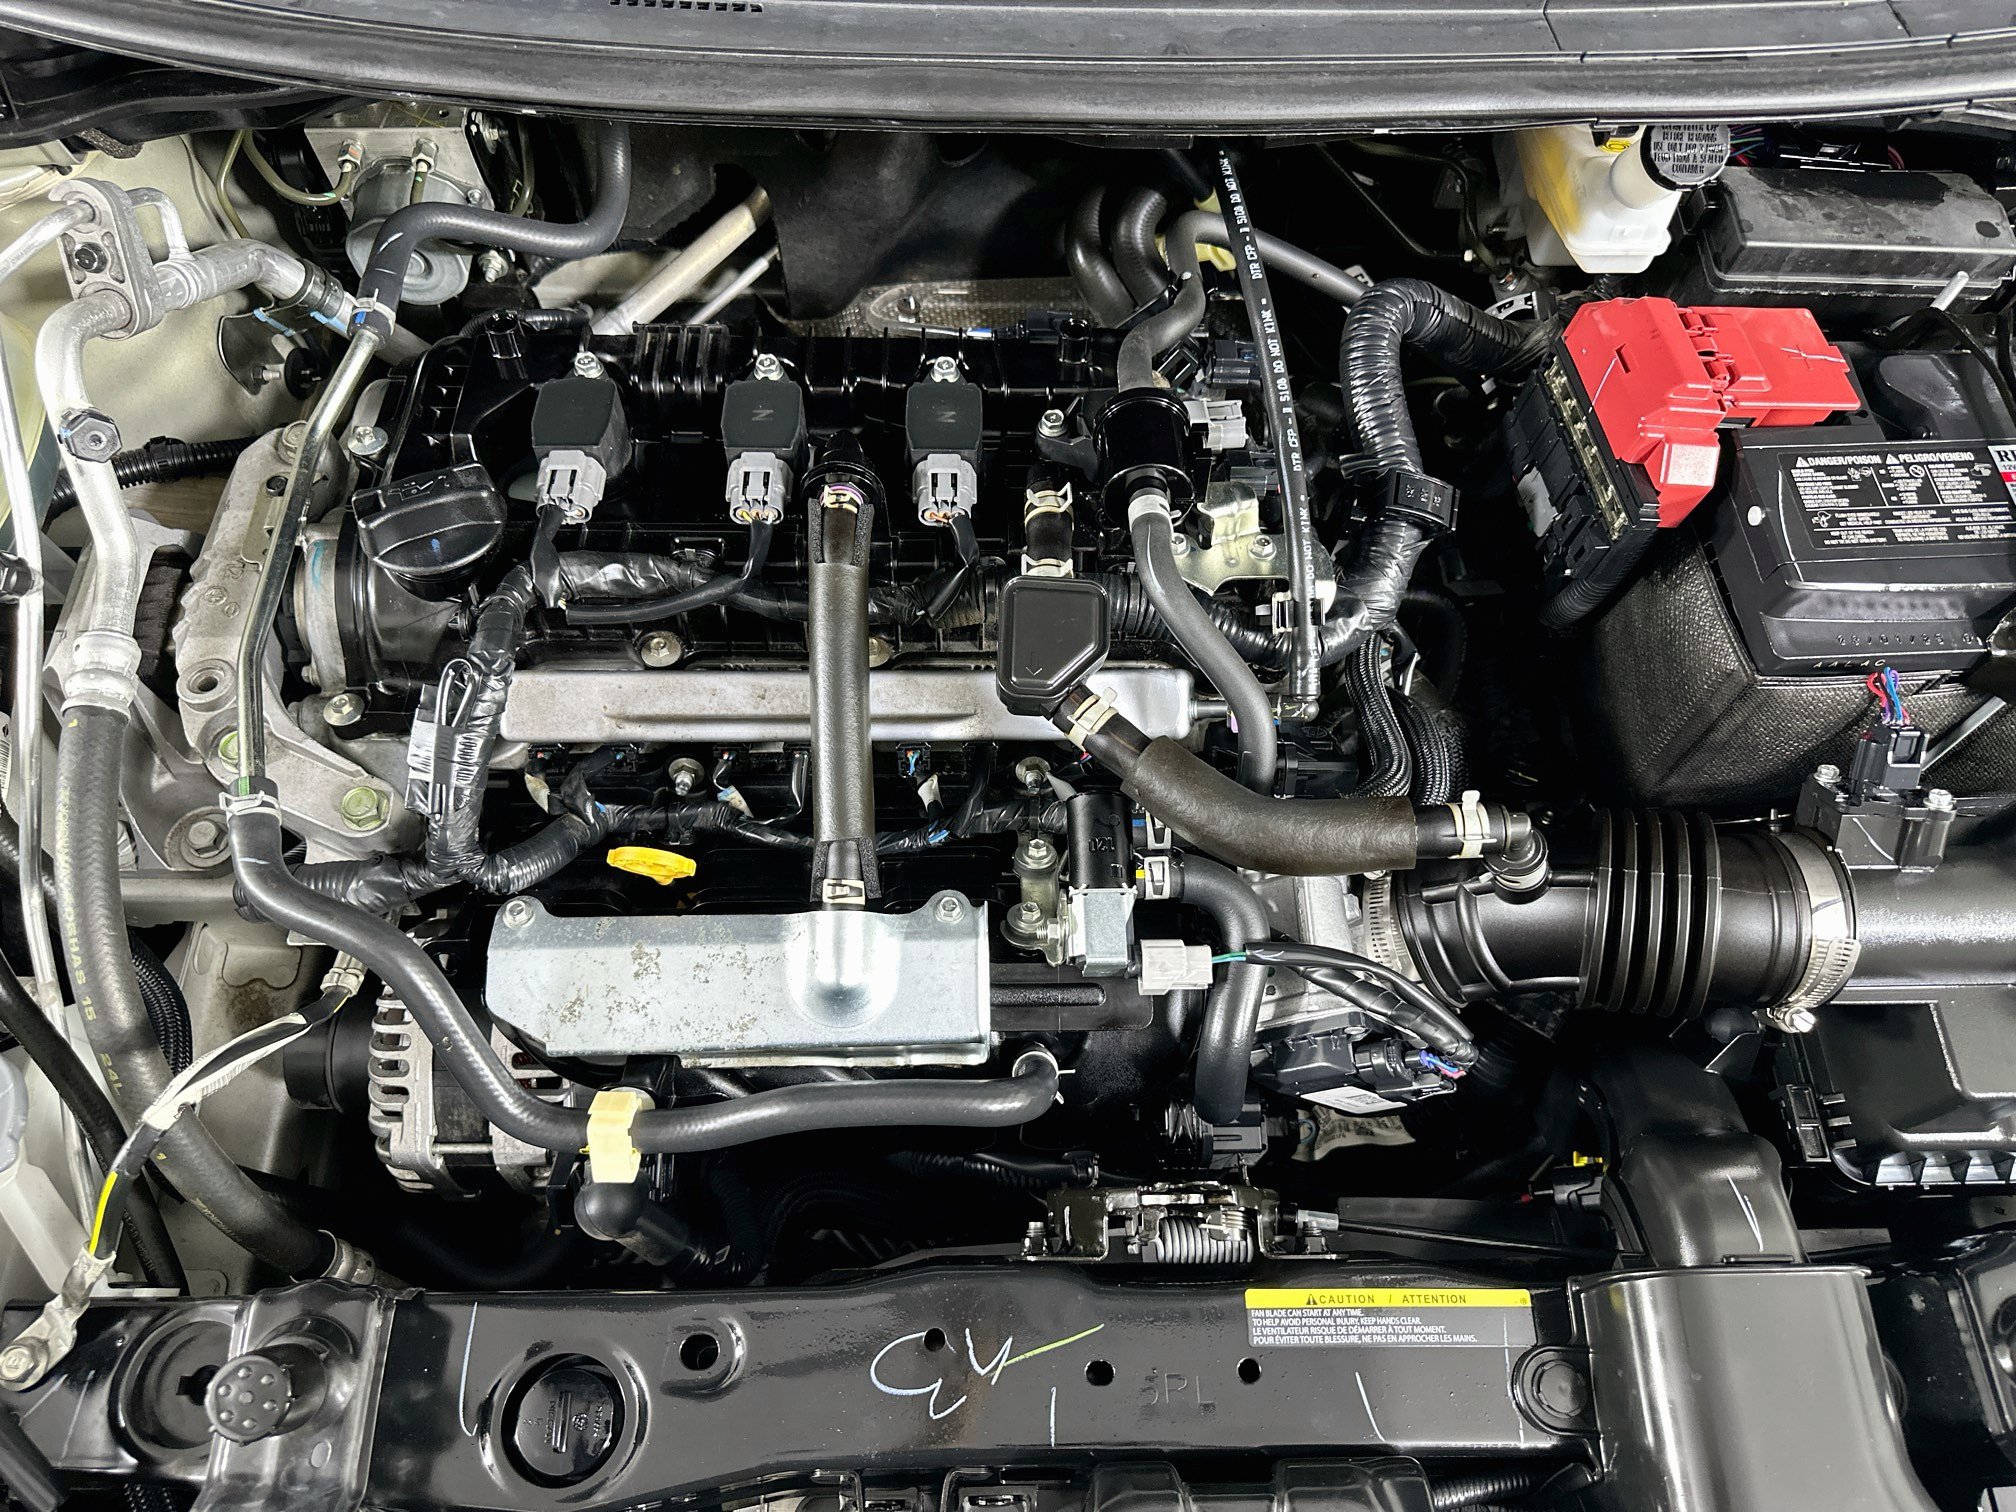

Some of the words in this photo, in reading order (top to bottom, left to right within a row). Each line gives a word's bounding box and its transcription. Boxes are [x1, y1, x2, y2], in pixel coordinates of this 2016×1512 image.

[1224, 178, 1237, 191] NOT
[1229, 193, 1241, 203] DO
[1244, 244, 1257, 260] CFP
[1249, 262, 1262, 280] DTR
[1261, 309, 1276, 334] KINK
[1267, 339, 1281, 357] NOT
[1272, 360, 1285, 373] DO
[1286, 428, 1299, 448] CFP
[1291, 452, 1302, 472] DTR
[1807, 455, 1882, 466] DANGER/POISON
[1898, 451, 1975, 463] PELIGRO/VENENO
[1299, 506, 1311, 533] KINK
[1302, 539, 1313, 560] NOT
[1319, 1294, 1375, 1304] CAUTION
[1402, 1294, 1467, 1304] ATTENTION
[1251, 1309, 1265, 1317] FAN
[1265, 1309, 1287, 1317] BLADE
[1287, 1309, 1301, 1317] CAN
[1302, 1309, 1322, 1317] START
[1347, 1308, 1364, 1316] TIME.
[1252, 1318, 1262, 1326] TO
[1263, 1318, 1280, 1326] HELP
[1302, 1317, 1335, 1326] PERSONAL
[1336, 1317, 1360, 1326] INJURY,
[1361, 1317, 1376, 1325] KEEP
[1377, 1317, 1400, 1325] HANDS
[1400, 1317, 1422, 1325] CLEAR.
[1262, 1327, 1309, 1335] VENTILATEUR
[1310, 1327, 1337, 1335] RISQUE
[1338, 1327, 1347, 1335] DE
[1348, 1325, 1387, 1334] DÉMARRER
[1394, 1326, 1413, 1334] TOUT
[1414, 1326, 1446, 1334] MOMENT.
[1253, 1336, 1274, 1345] POUR
[1275, 1334, 1299, 1344] ÉVITER
[1299, 1336, 1323, 1344] TOUTE
[1324, 1335, 1361, 1344] BLESSURE,
[1362, 1335, 1372, 1343] NE
[1373, 1335, 1386, 1343] PAS
[1387, 1335, 1397, 1343] EN
[1397, 1335, 1440, 1343] APPROCHER
[1453, 1335, 1477, 1343] MAINS.
